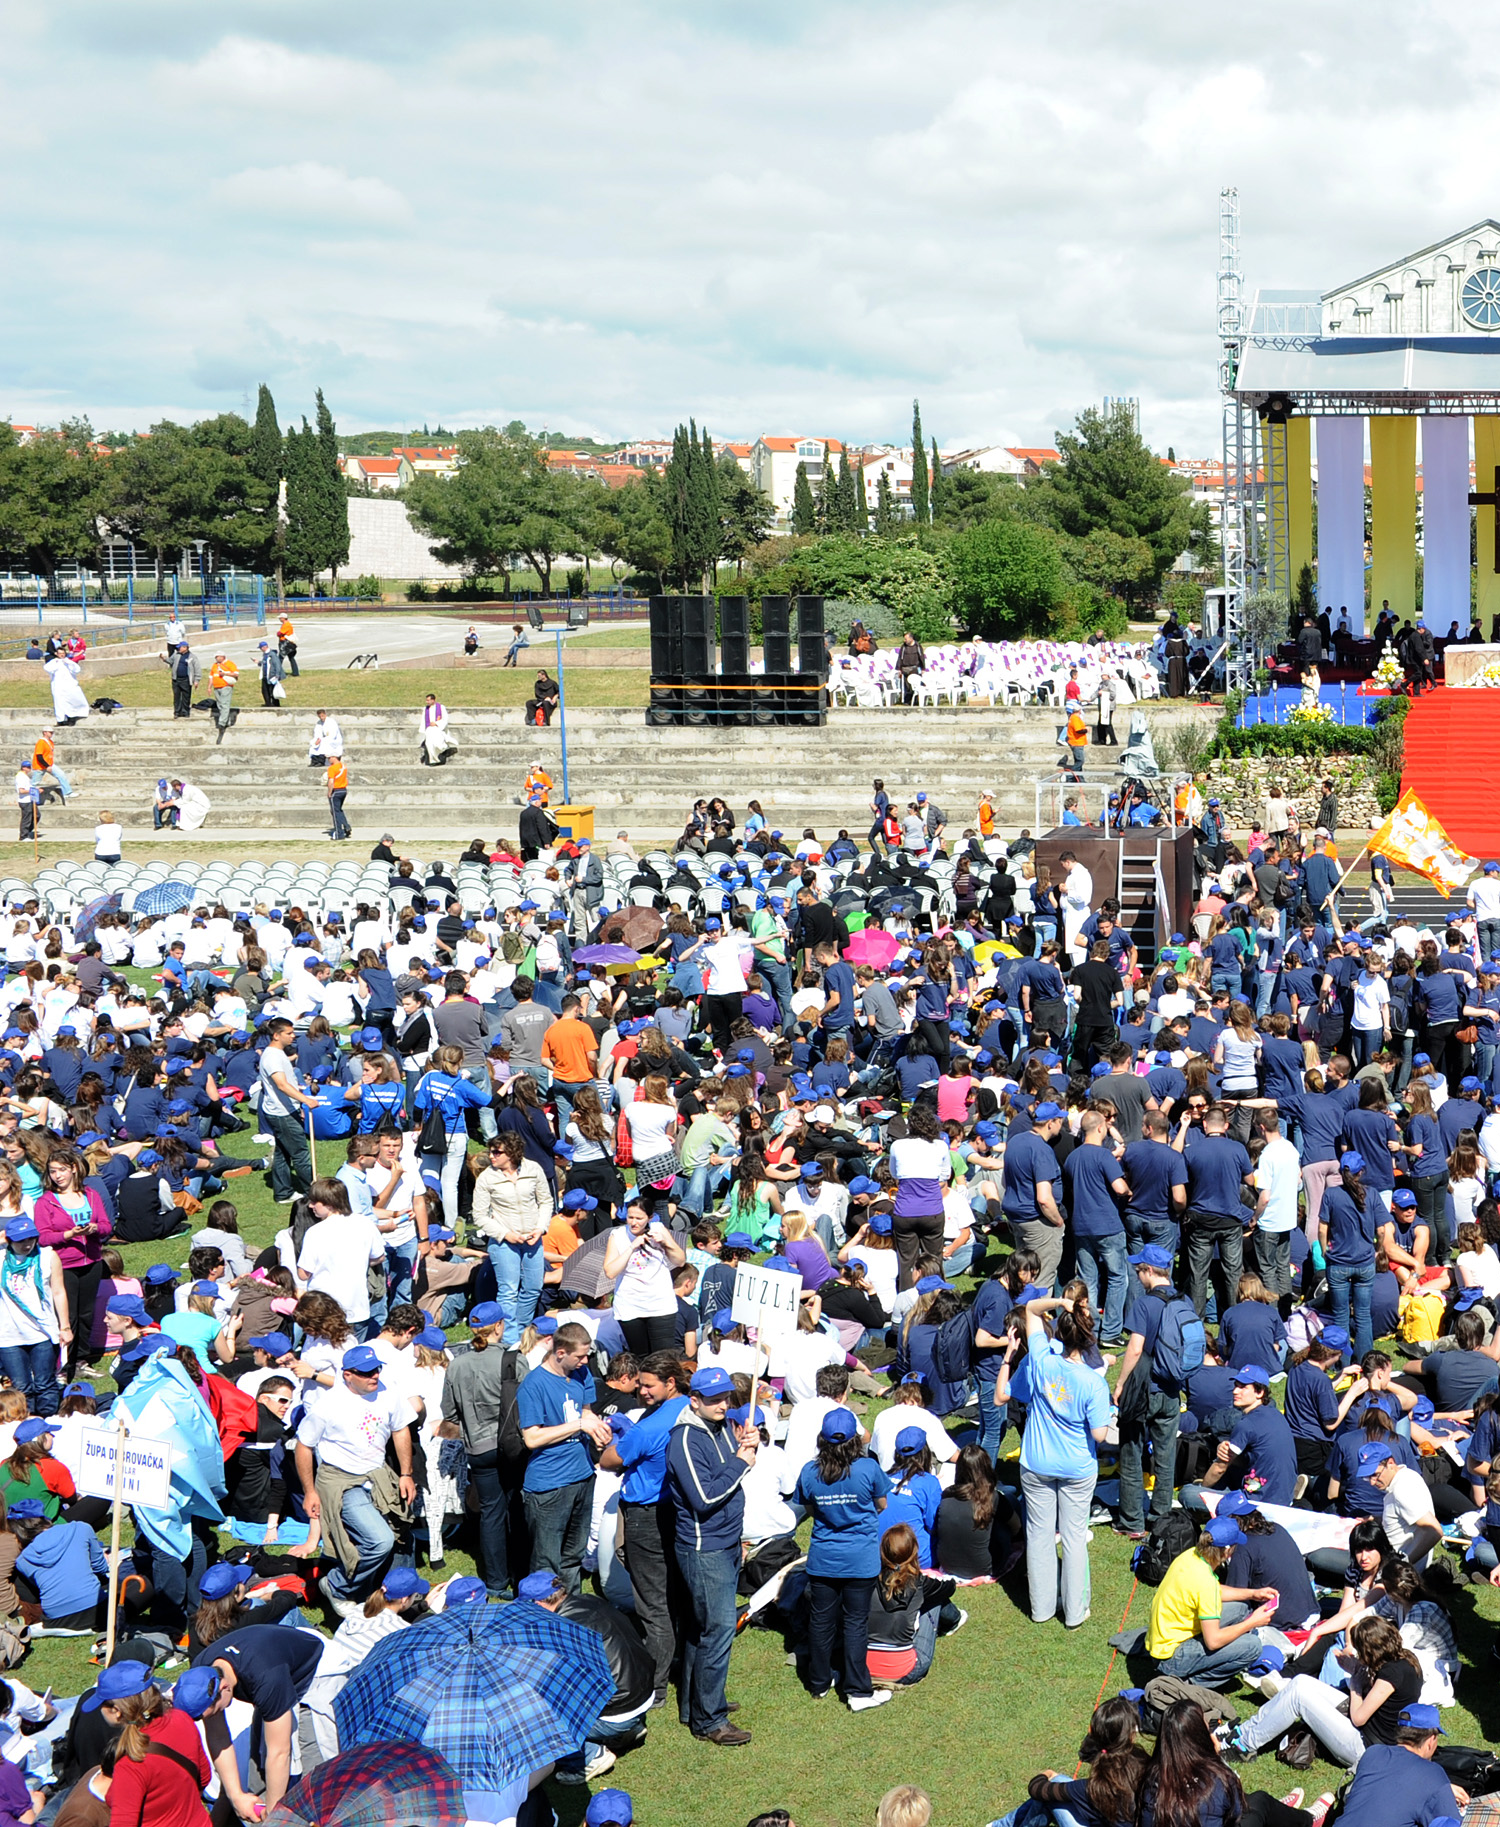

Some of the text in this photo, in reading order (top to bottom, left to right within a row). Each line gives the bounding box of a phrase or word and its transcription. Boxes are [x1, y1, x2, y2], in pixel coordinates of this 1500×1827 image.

[736, 1273, 795, 1312] TUZLA
[85, 1440, 164, 1470] ŽUPA DROVAČKA
[106, 1473, 140, 1492] MINI
